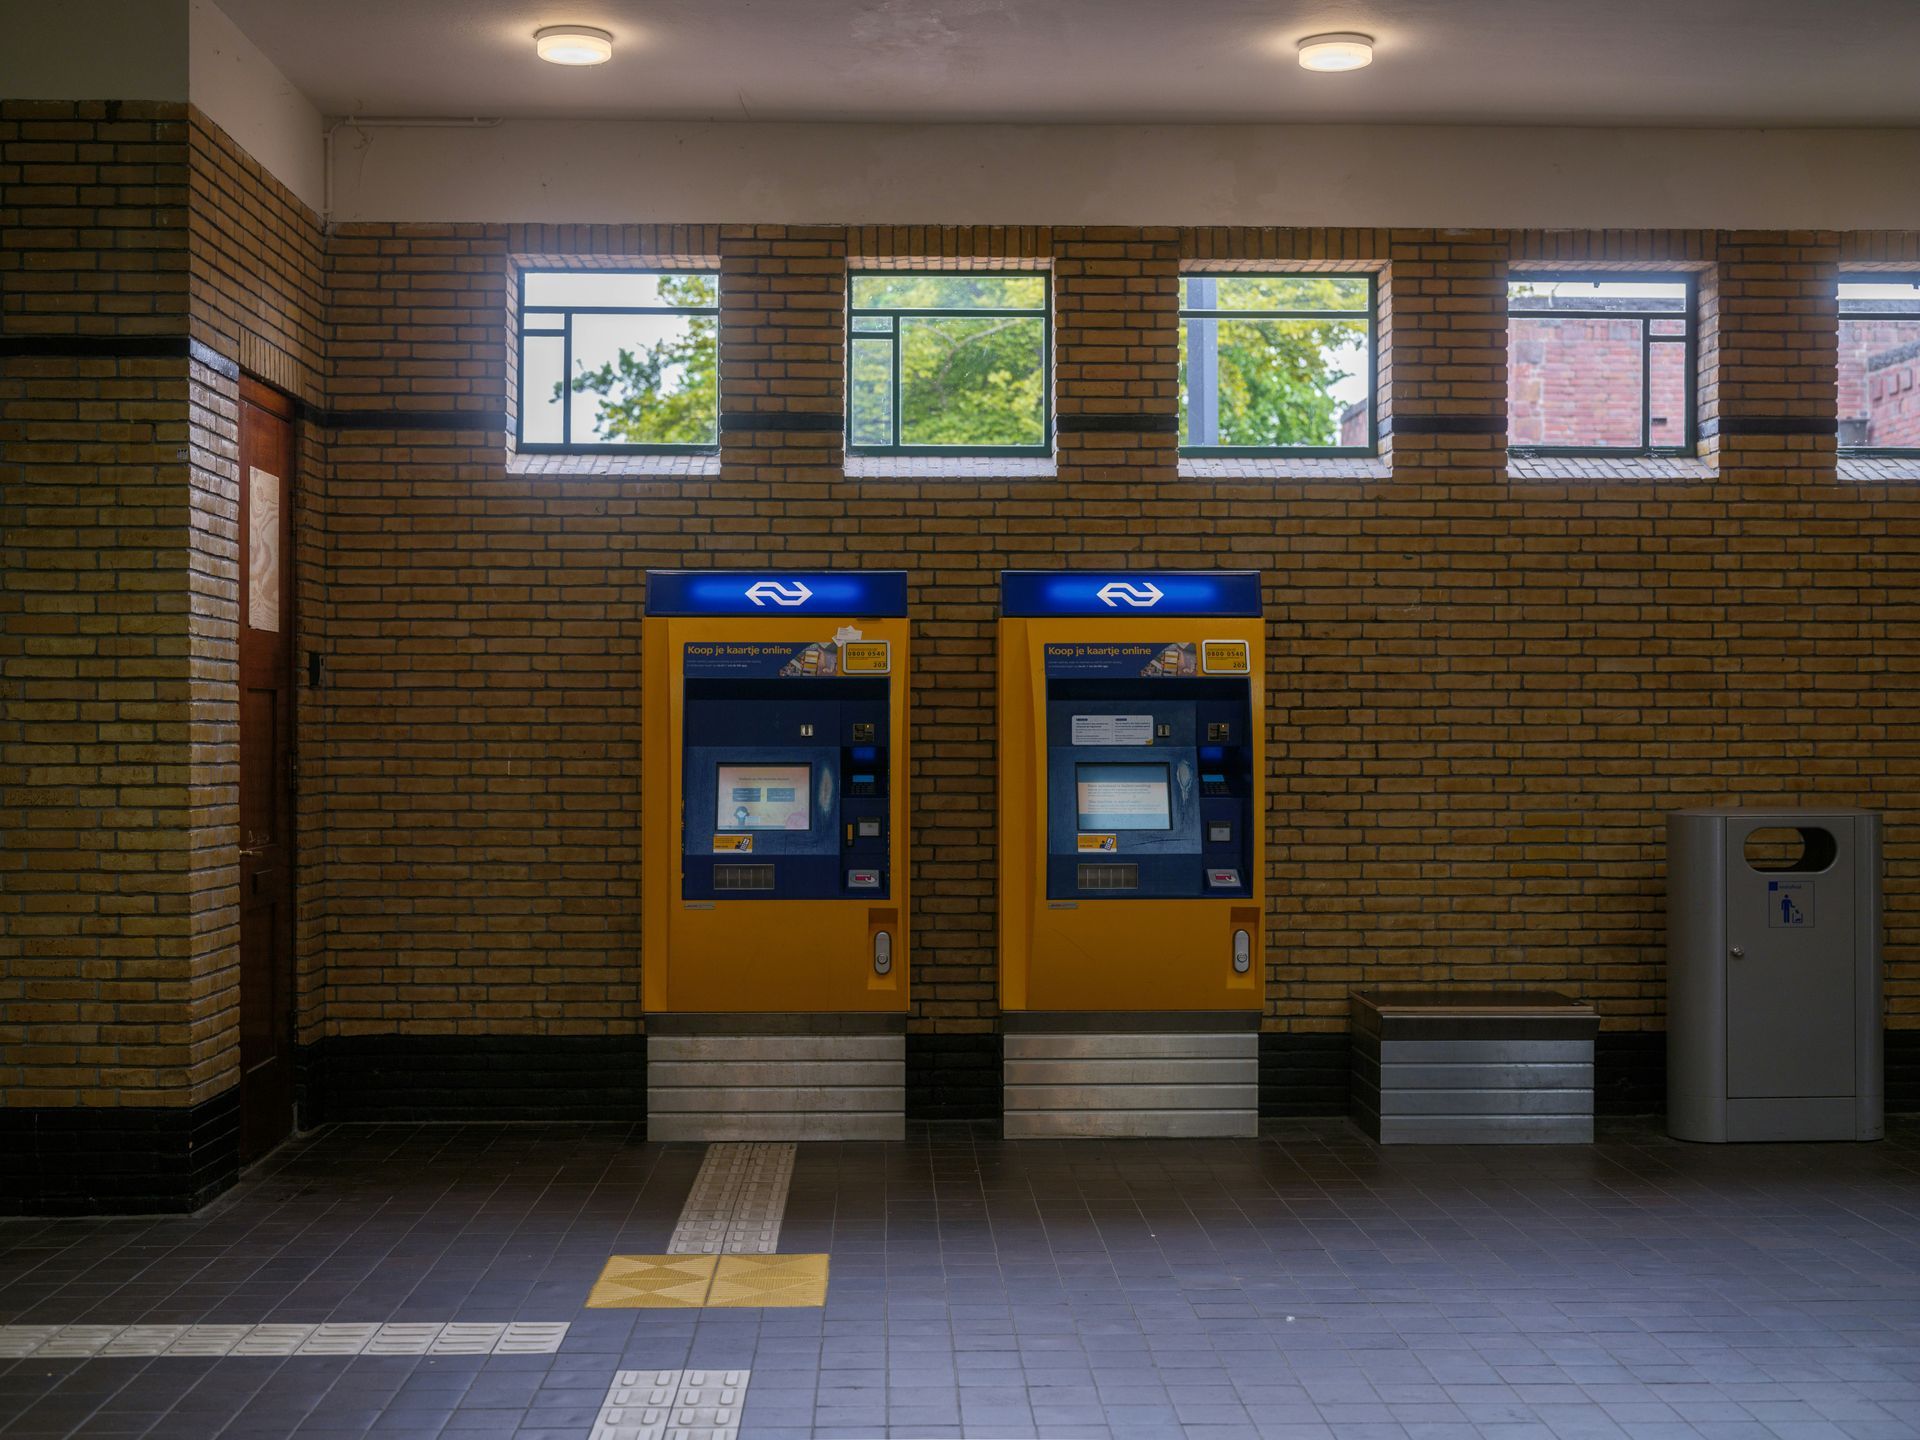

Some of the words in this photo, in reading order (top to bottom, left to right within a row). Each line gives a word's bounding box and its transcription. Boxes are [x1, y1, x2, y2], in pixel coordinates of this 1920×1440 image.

[687, 645, 713, 656] Koop
[715, 645, 725, 656] je
[727, 645, 760, 656] kaartje
[762, 645, 792, 655] online
[1048, 646, 1074, 657] Koop
[1075, 646, 1086, 657] je
[1087, 646, 1120, 657] kaartje
[1122, 646, 1152, 655] online
